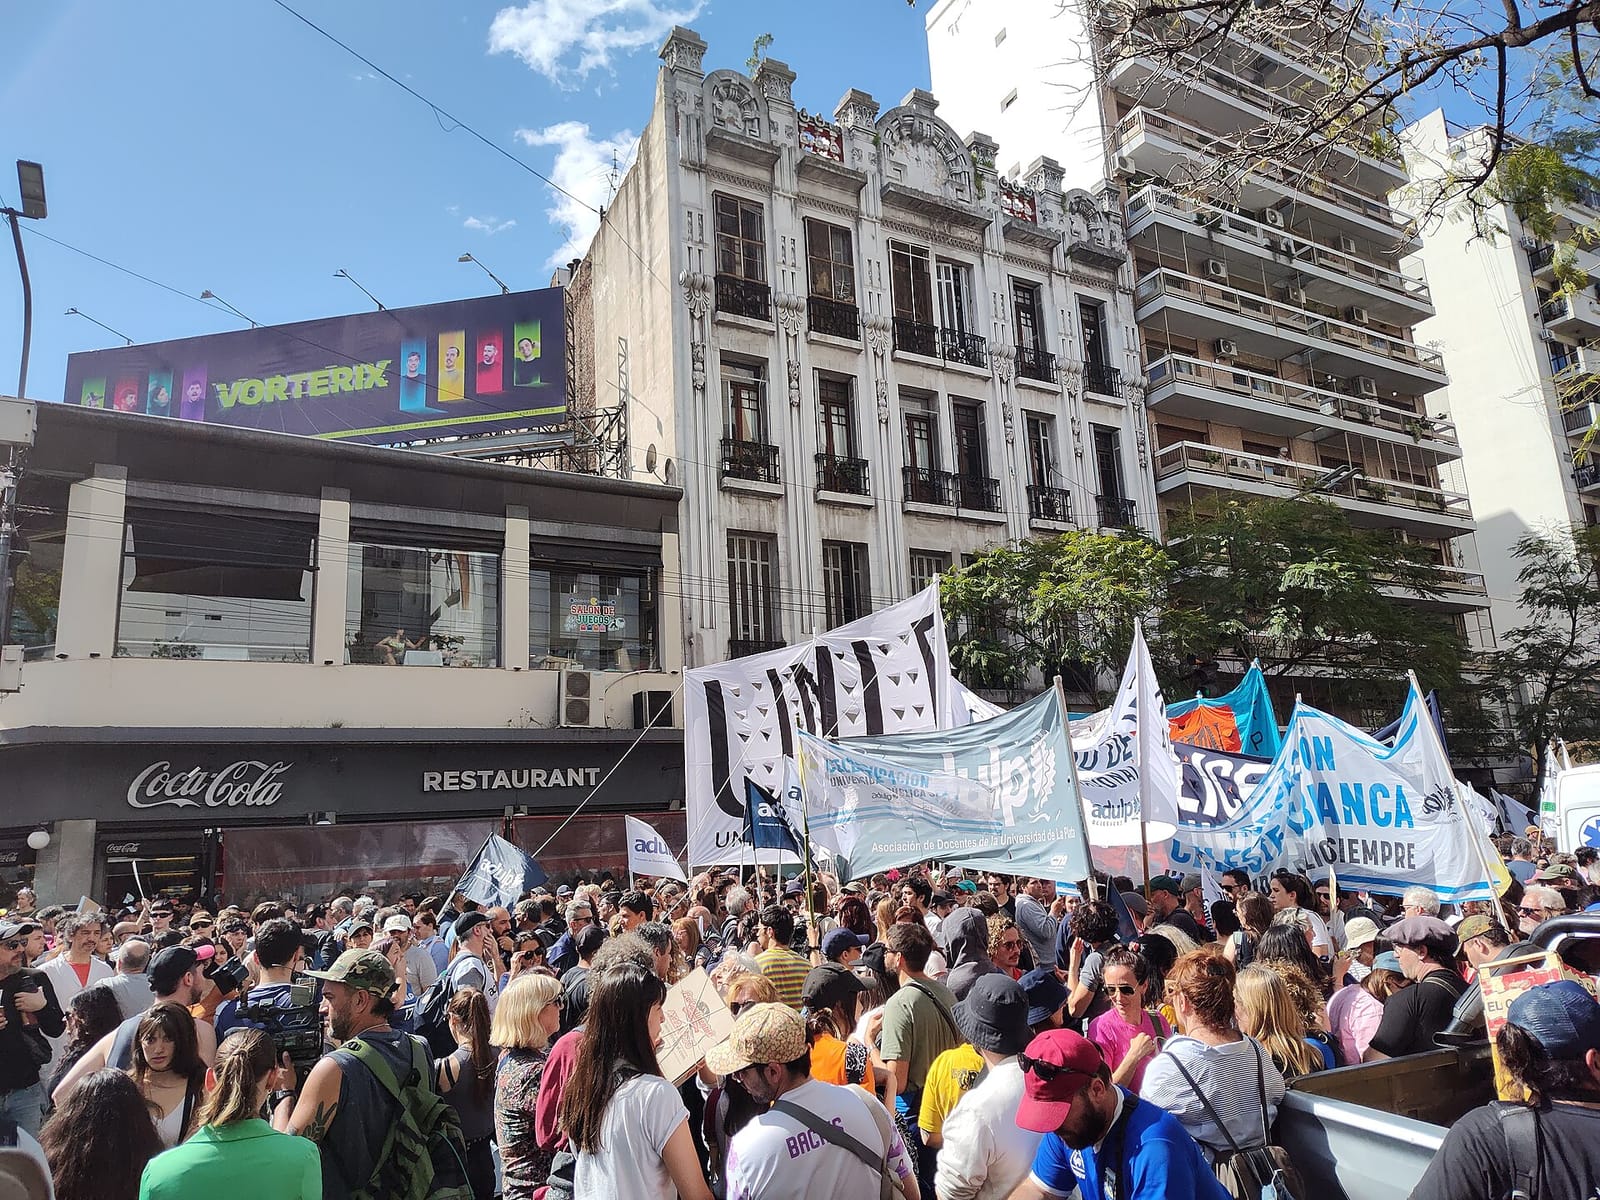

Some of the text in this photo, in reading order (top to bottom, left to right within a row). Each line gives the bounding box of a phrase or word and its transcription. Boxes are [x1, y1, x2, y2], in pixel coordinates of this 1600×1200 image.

[212, 360, 392, 408] VORTERIX
[571, 605, 615, 615] SALON DE
[577, 615, 610, 624] JUEGOS
[127, 761, 296, 809] Coca-Cola
[423, 768, 600, 792] RESTAURANT
[1091, 798, 1134, 823] adulp
[872, 840, 920, 852] Asociación
[924, 840, 934, 850] de
[938, 838, 977, 849] Docentes
[979, 837, 989, 847] de
[991, 835, 999, 846] la
[1001, 829, 1046, 846] Universidad
[1048, 829, 1055, 840] de
[1056, 827, 1063, 840] La
